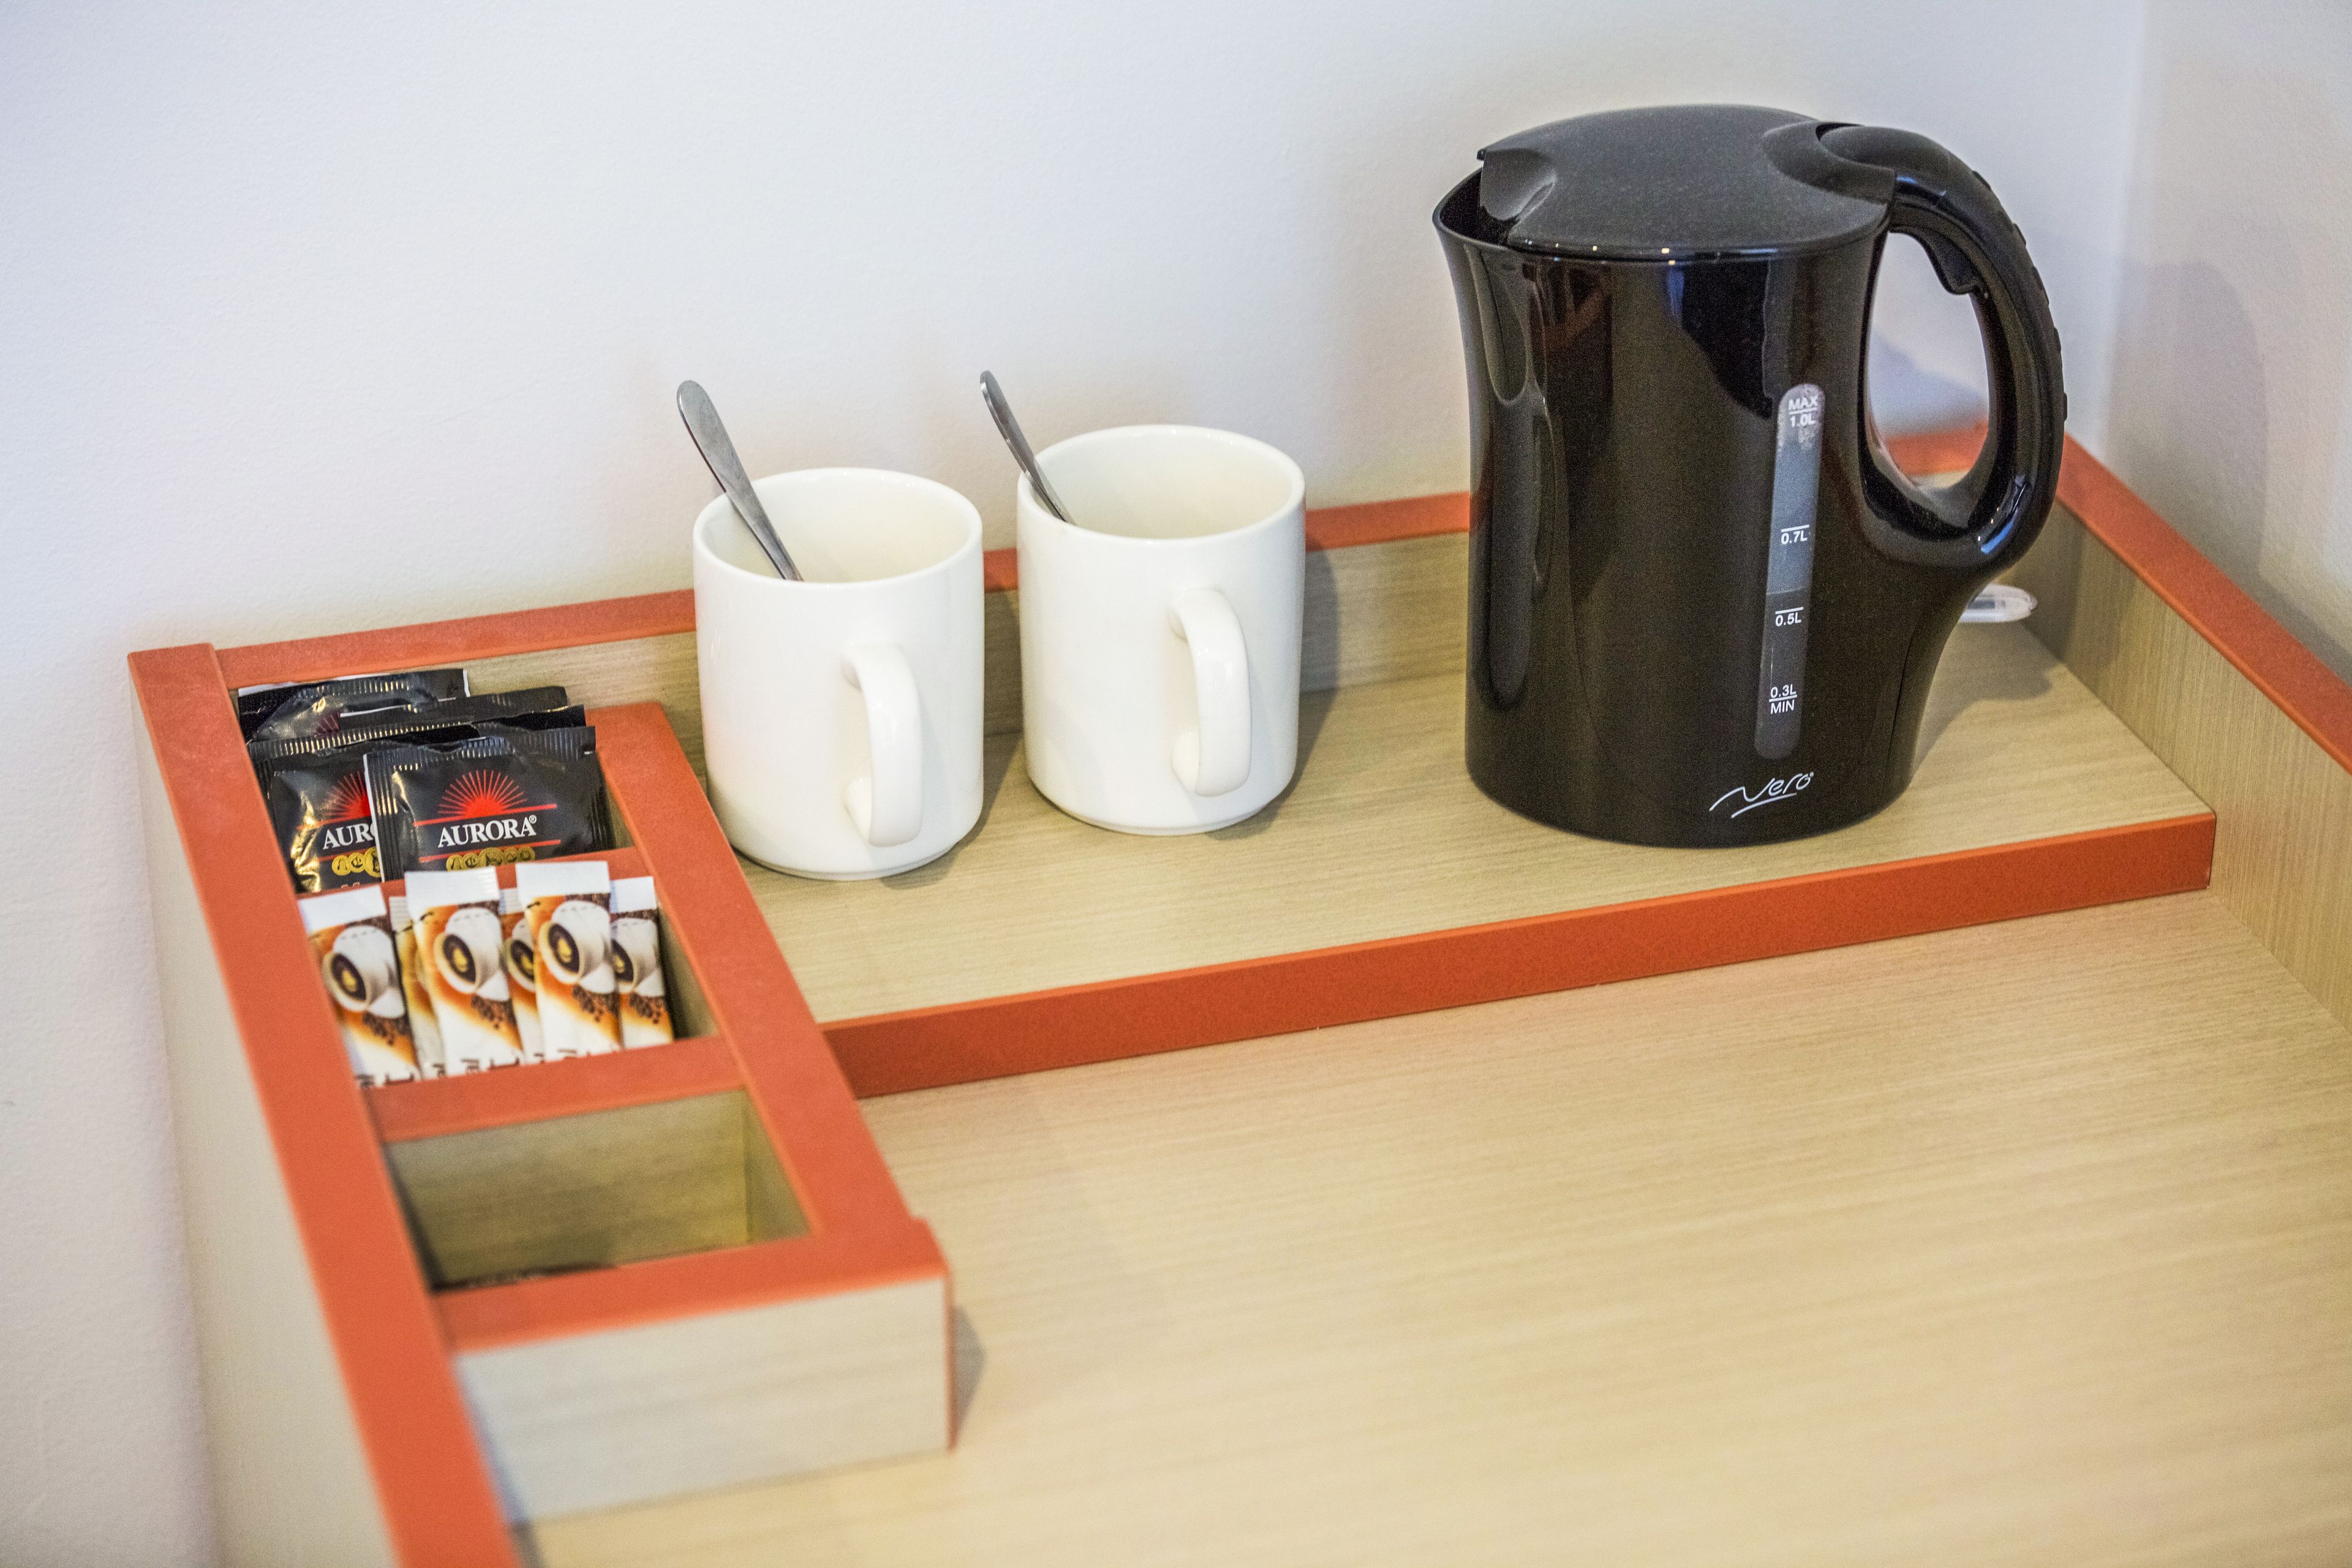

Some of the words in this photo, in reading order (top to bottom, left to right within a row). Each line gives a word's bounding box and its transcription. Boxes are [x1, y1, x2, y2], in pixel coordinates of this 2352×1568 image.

[1788, 396, 1818, 411] MAX
[1790, 413, 1816, 428] 1.0L
[1781, 530, 1807, 545] 0.7L
[1776, 612, 1802, 627] 0.5L
[1770, 684, 1796, 698] 0.3L
[1770, 699, 1795, 714] MIN
